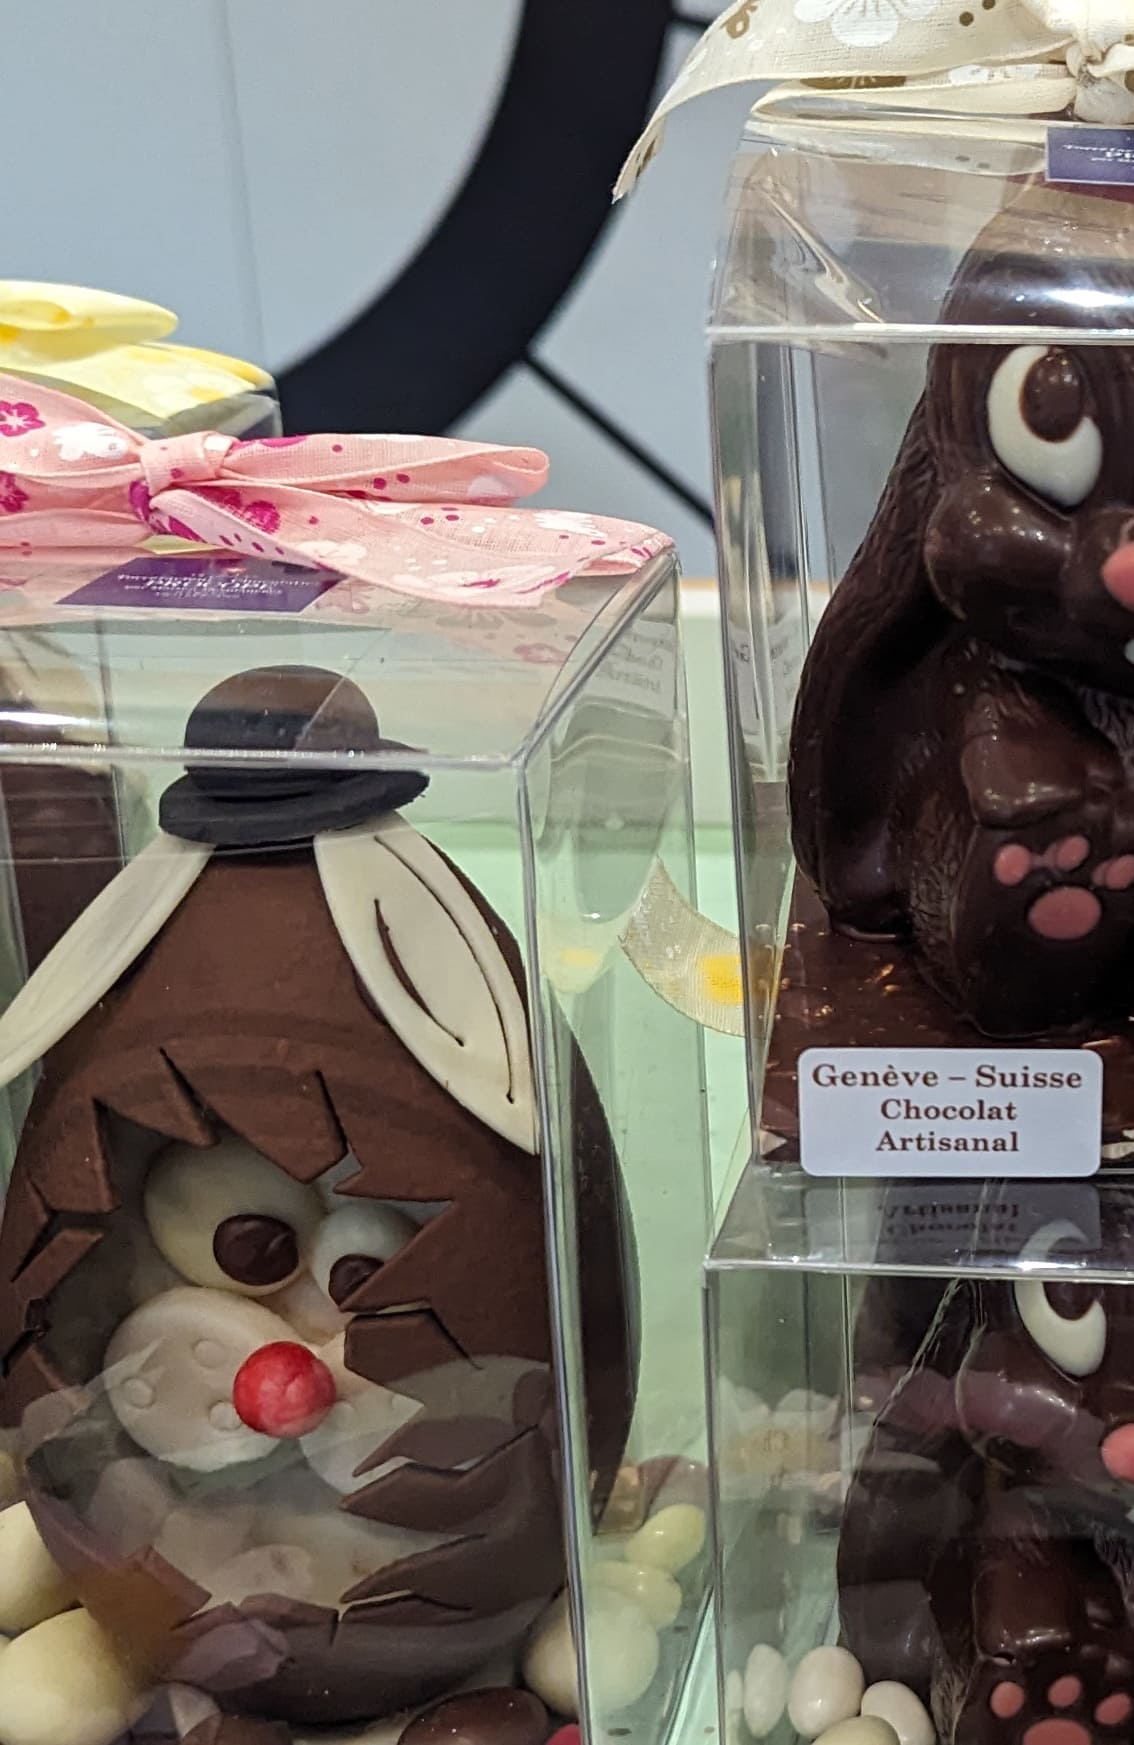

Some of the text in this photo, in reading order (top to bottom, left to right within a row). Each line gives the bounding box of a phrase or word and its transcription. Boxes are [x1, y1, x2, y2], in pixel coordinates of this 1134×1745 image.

[813, 1064, 938, 1087] Genève
[976, 1065, 1081, 1088] Suisse
[881, 1099, 1016, 1120] Chocolat
[876, 1131, 1018, 1151] Artisanal
